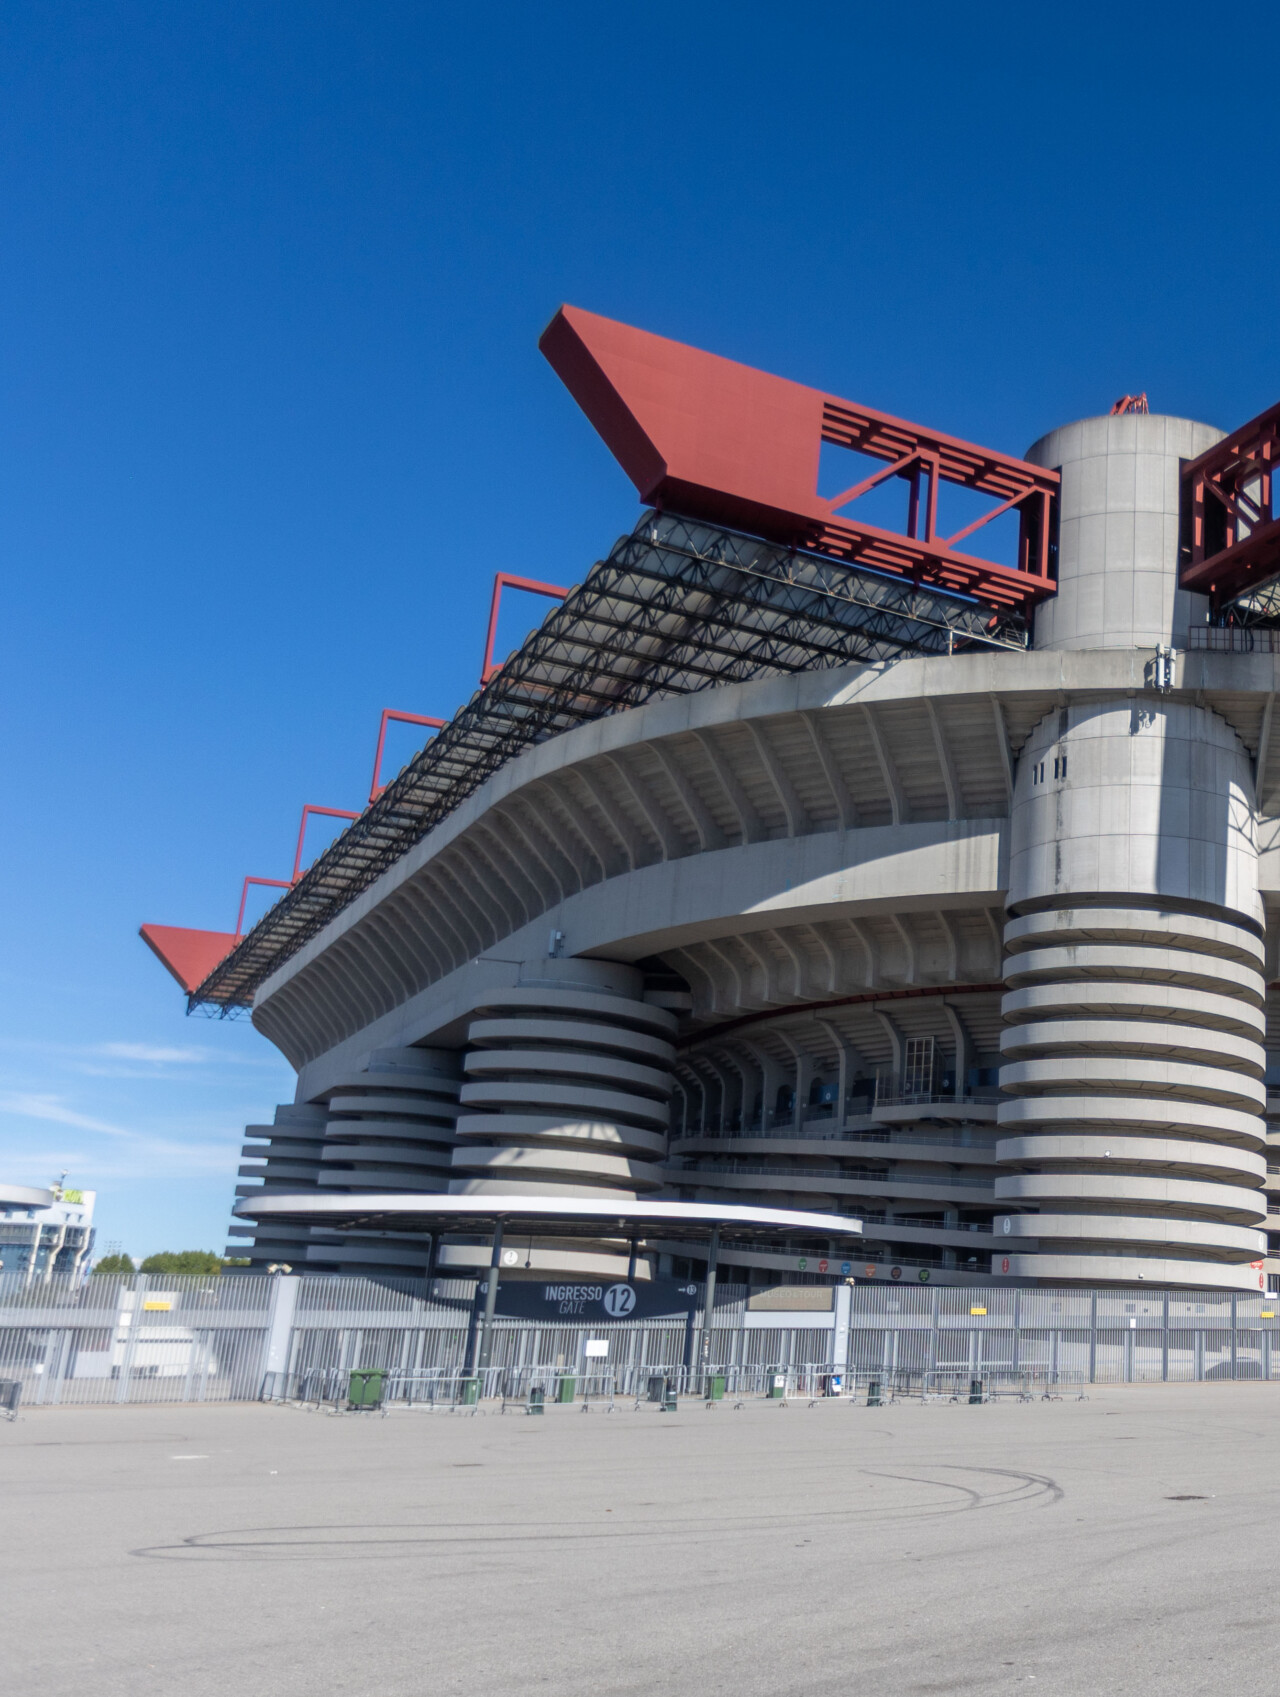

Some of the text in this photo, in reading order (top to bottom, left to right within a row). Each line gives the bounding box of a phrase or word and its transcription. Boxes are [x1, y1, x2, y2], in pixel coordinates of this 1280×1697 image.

[545, 1286, 632, 1312] INGRESSO 12
[799, 1290, 823, 1299] TOUR
[559, 1300, 587, 1314] GATE
